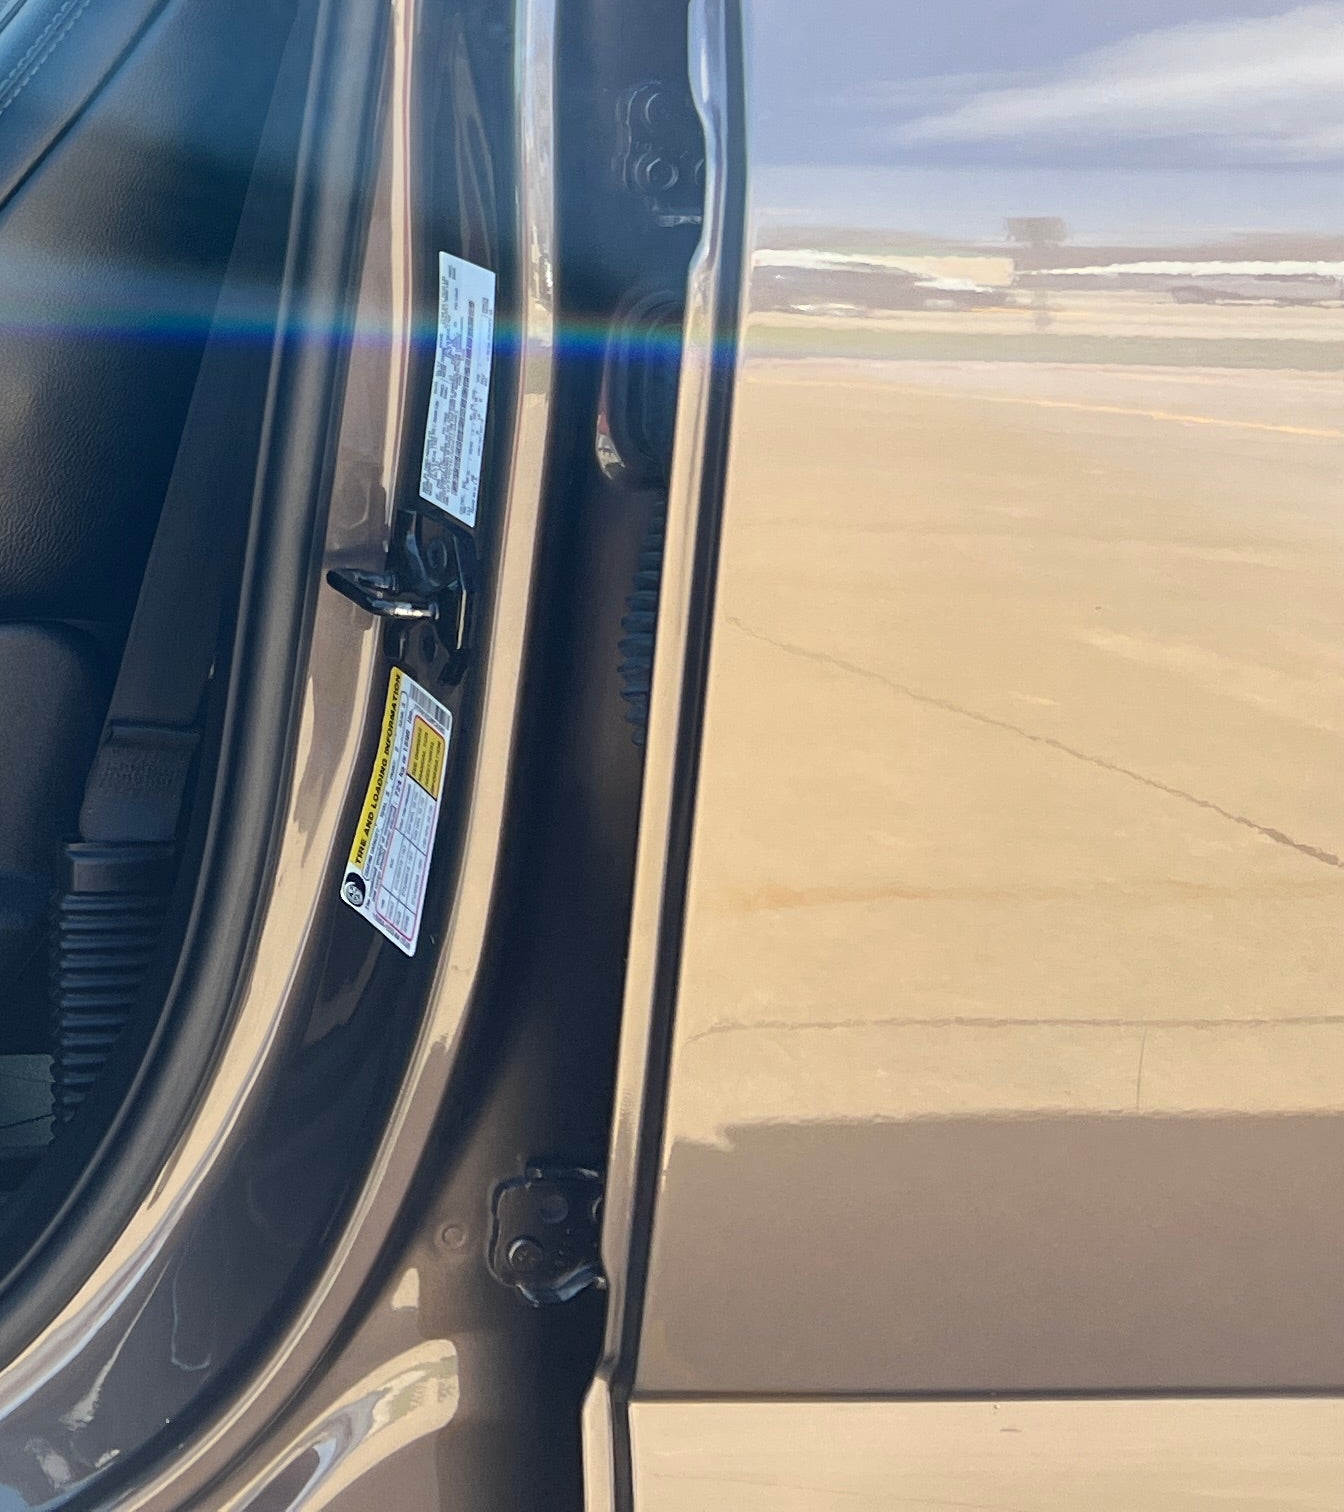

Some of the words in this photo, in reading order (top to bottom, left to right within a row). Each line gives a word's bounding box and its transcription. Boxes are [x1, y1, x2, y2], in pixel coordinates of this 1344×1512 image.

[364, 811, 374, 837] AND
[371, 758, 388, 809] LOADING
[384, 674, 401, 756] INFORMATION
